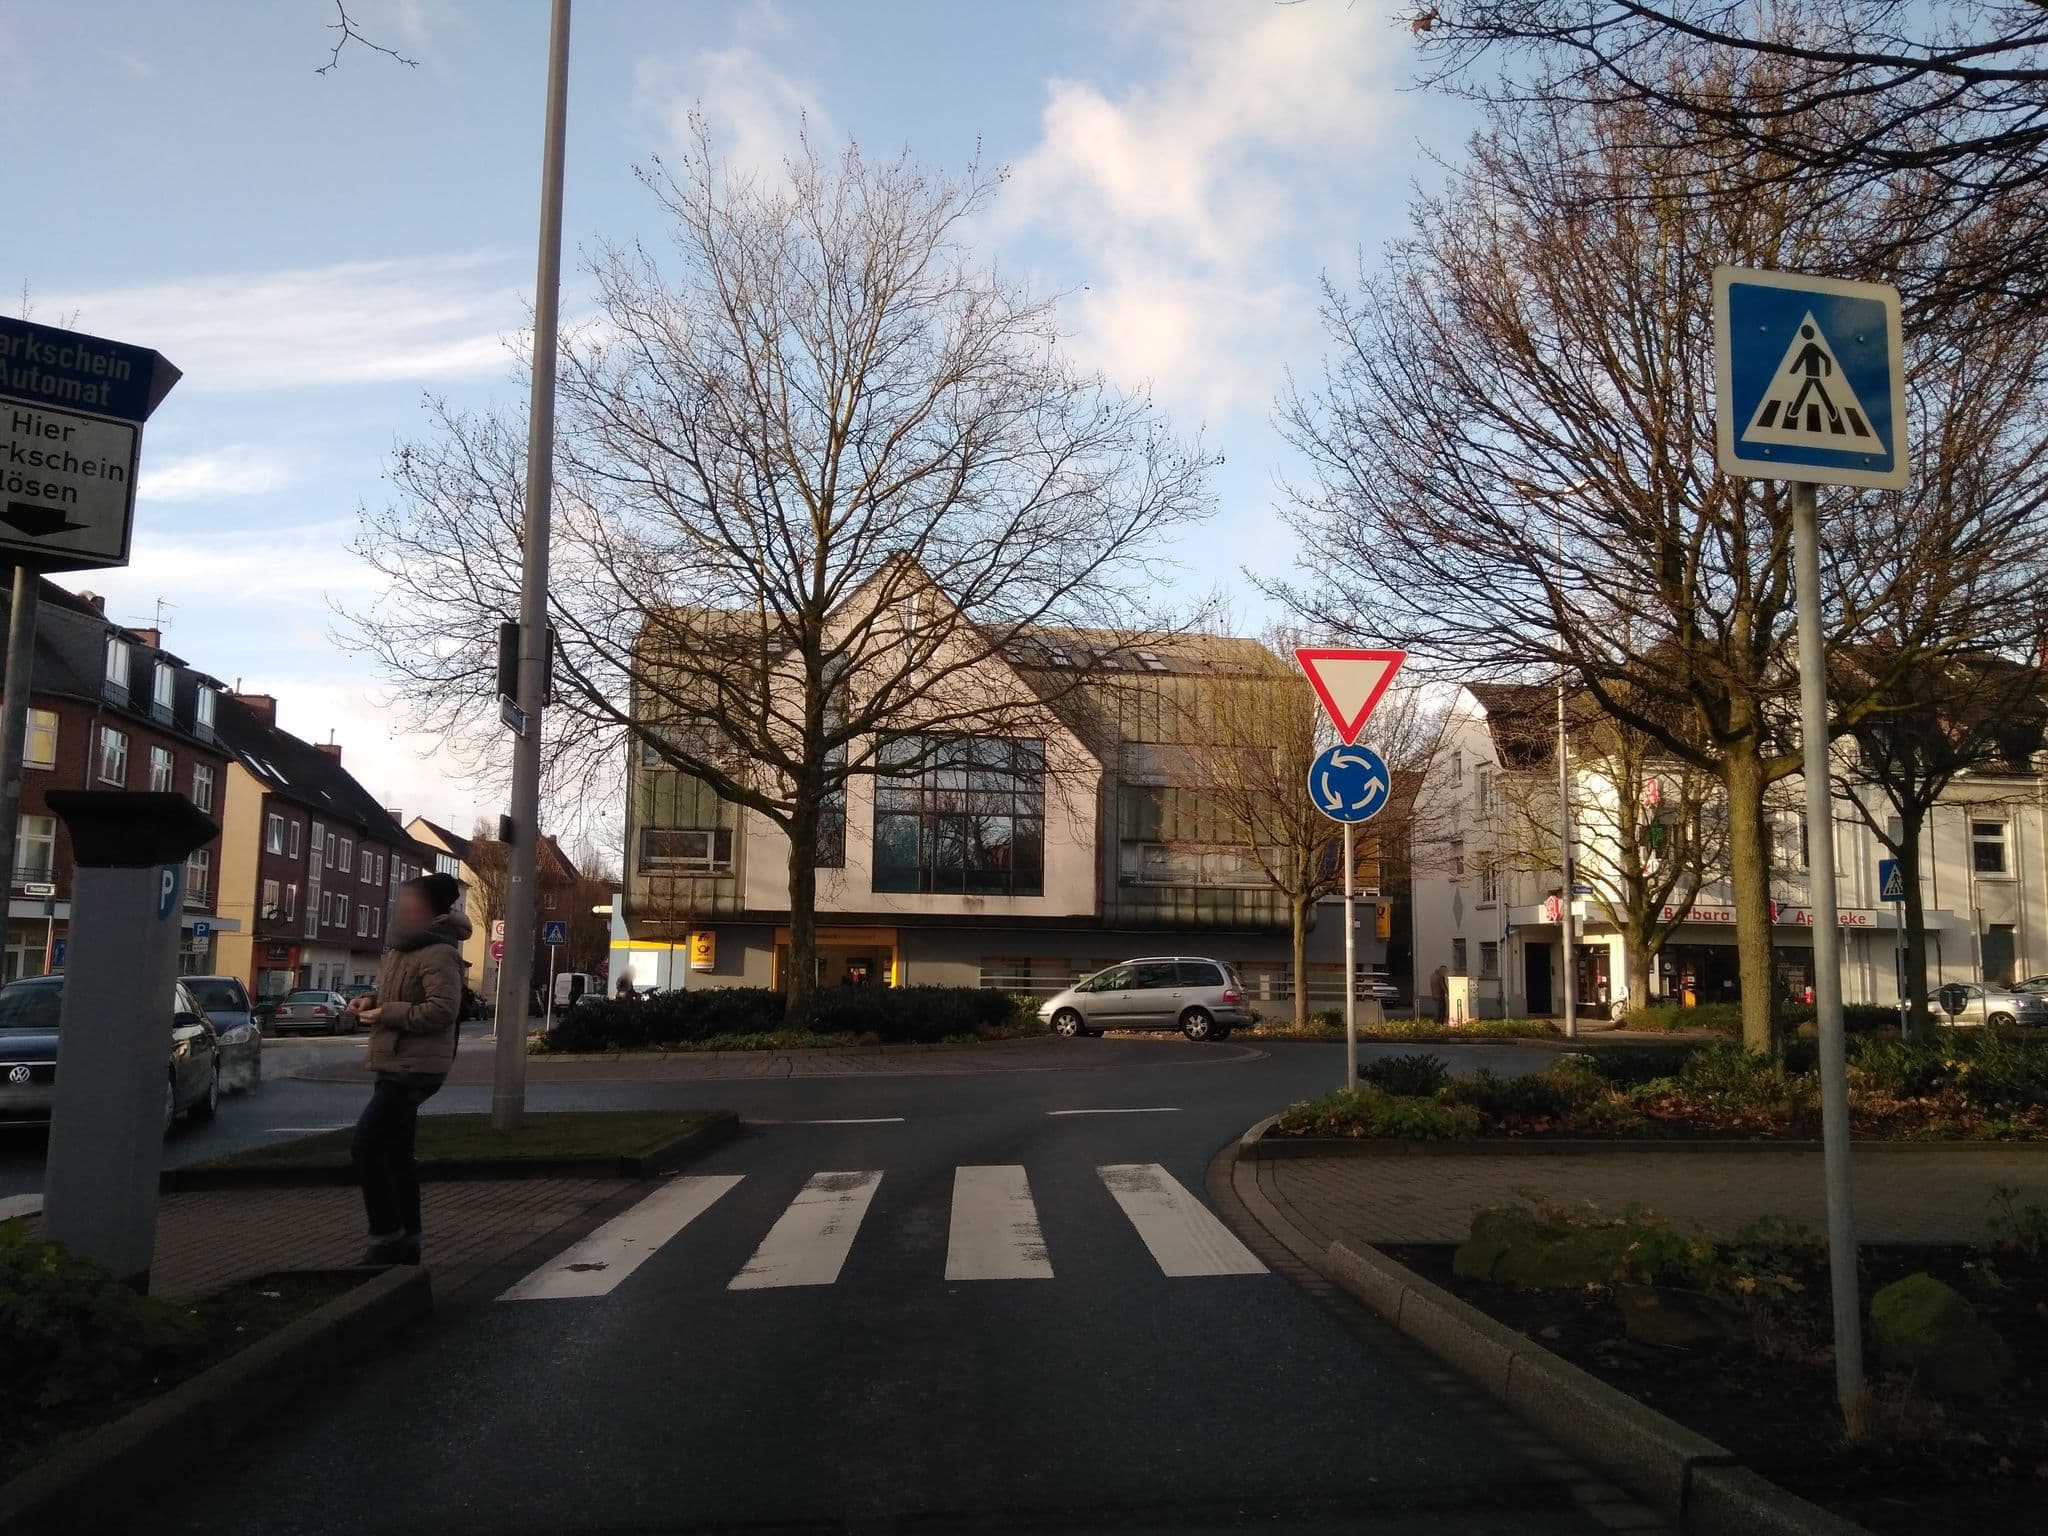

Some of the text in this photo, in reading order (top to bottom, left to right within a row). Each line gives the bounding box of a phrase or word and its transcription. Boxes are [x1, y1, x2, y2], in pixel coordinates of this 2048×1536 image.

[0, 332, 133, 382] arkschein
[12, 411, 76, 442] Hier
[0, 440, 124, 482] kschein
[160, 869, 175, 911] P
[197, 924, 206, 936] P
[1664, 907, 1866, 925] Brbara Apeke
